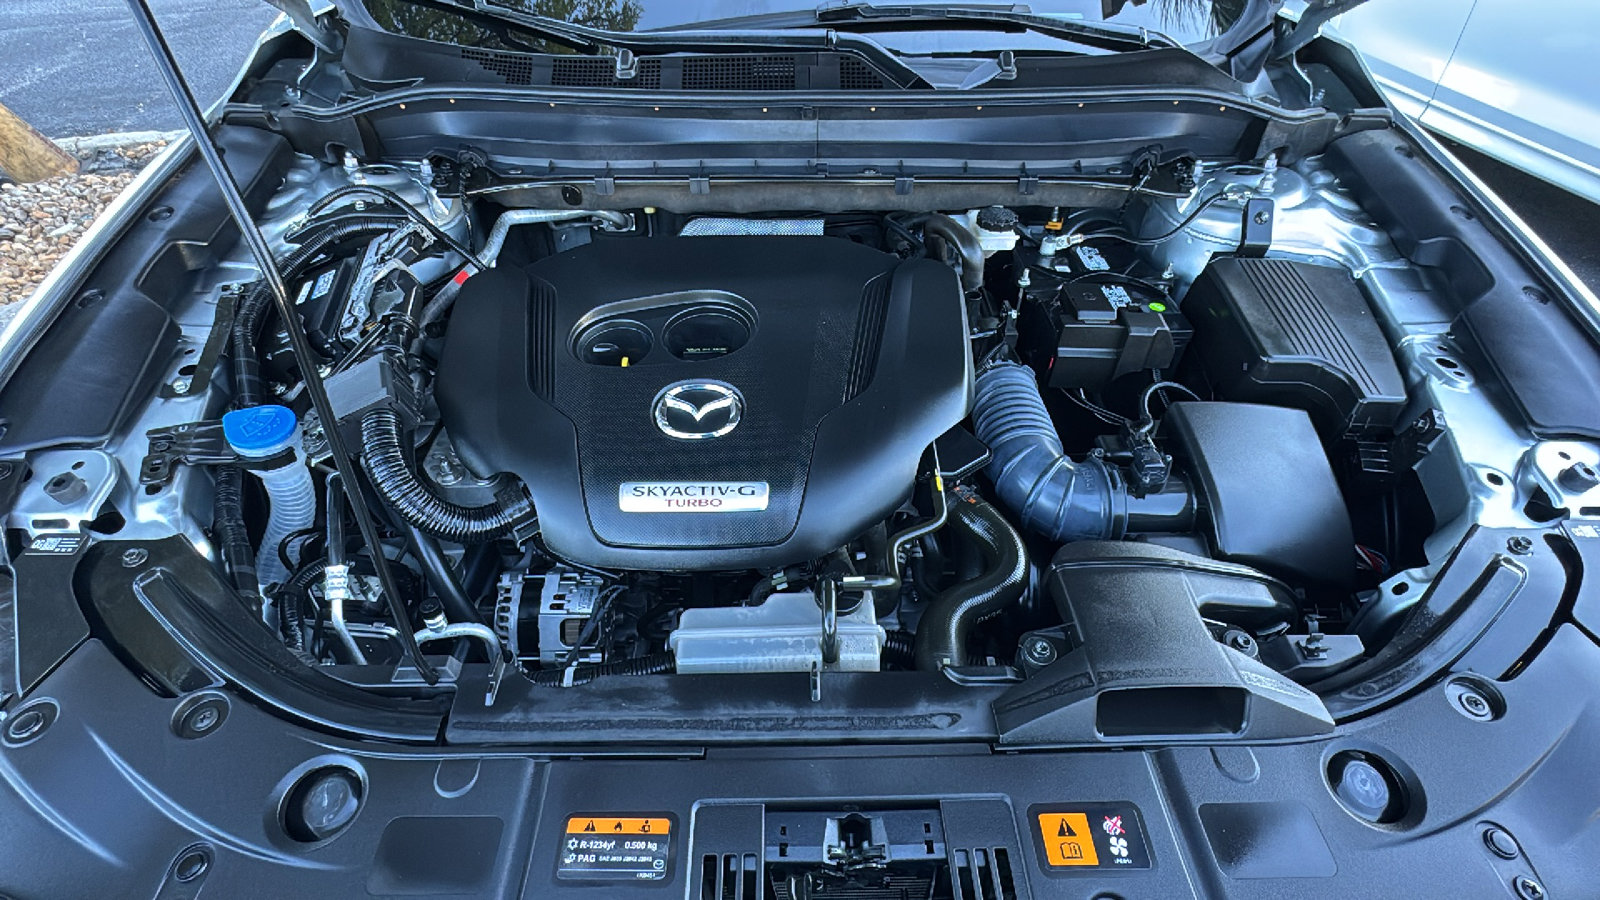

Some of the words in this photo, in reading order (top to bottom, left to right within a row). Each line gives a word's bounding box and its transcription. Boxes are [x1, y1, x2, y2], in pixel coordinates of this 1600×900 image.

[632, 485, 756, 496] SKYACTIV-G
[665, 498, 723, 507] TURBO
[579, 840, 616, 851] R-1234yf
[647, 840, 658, 851] kg
[577, 854, 596, 863] PAG
